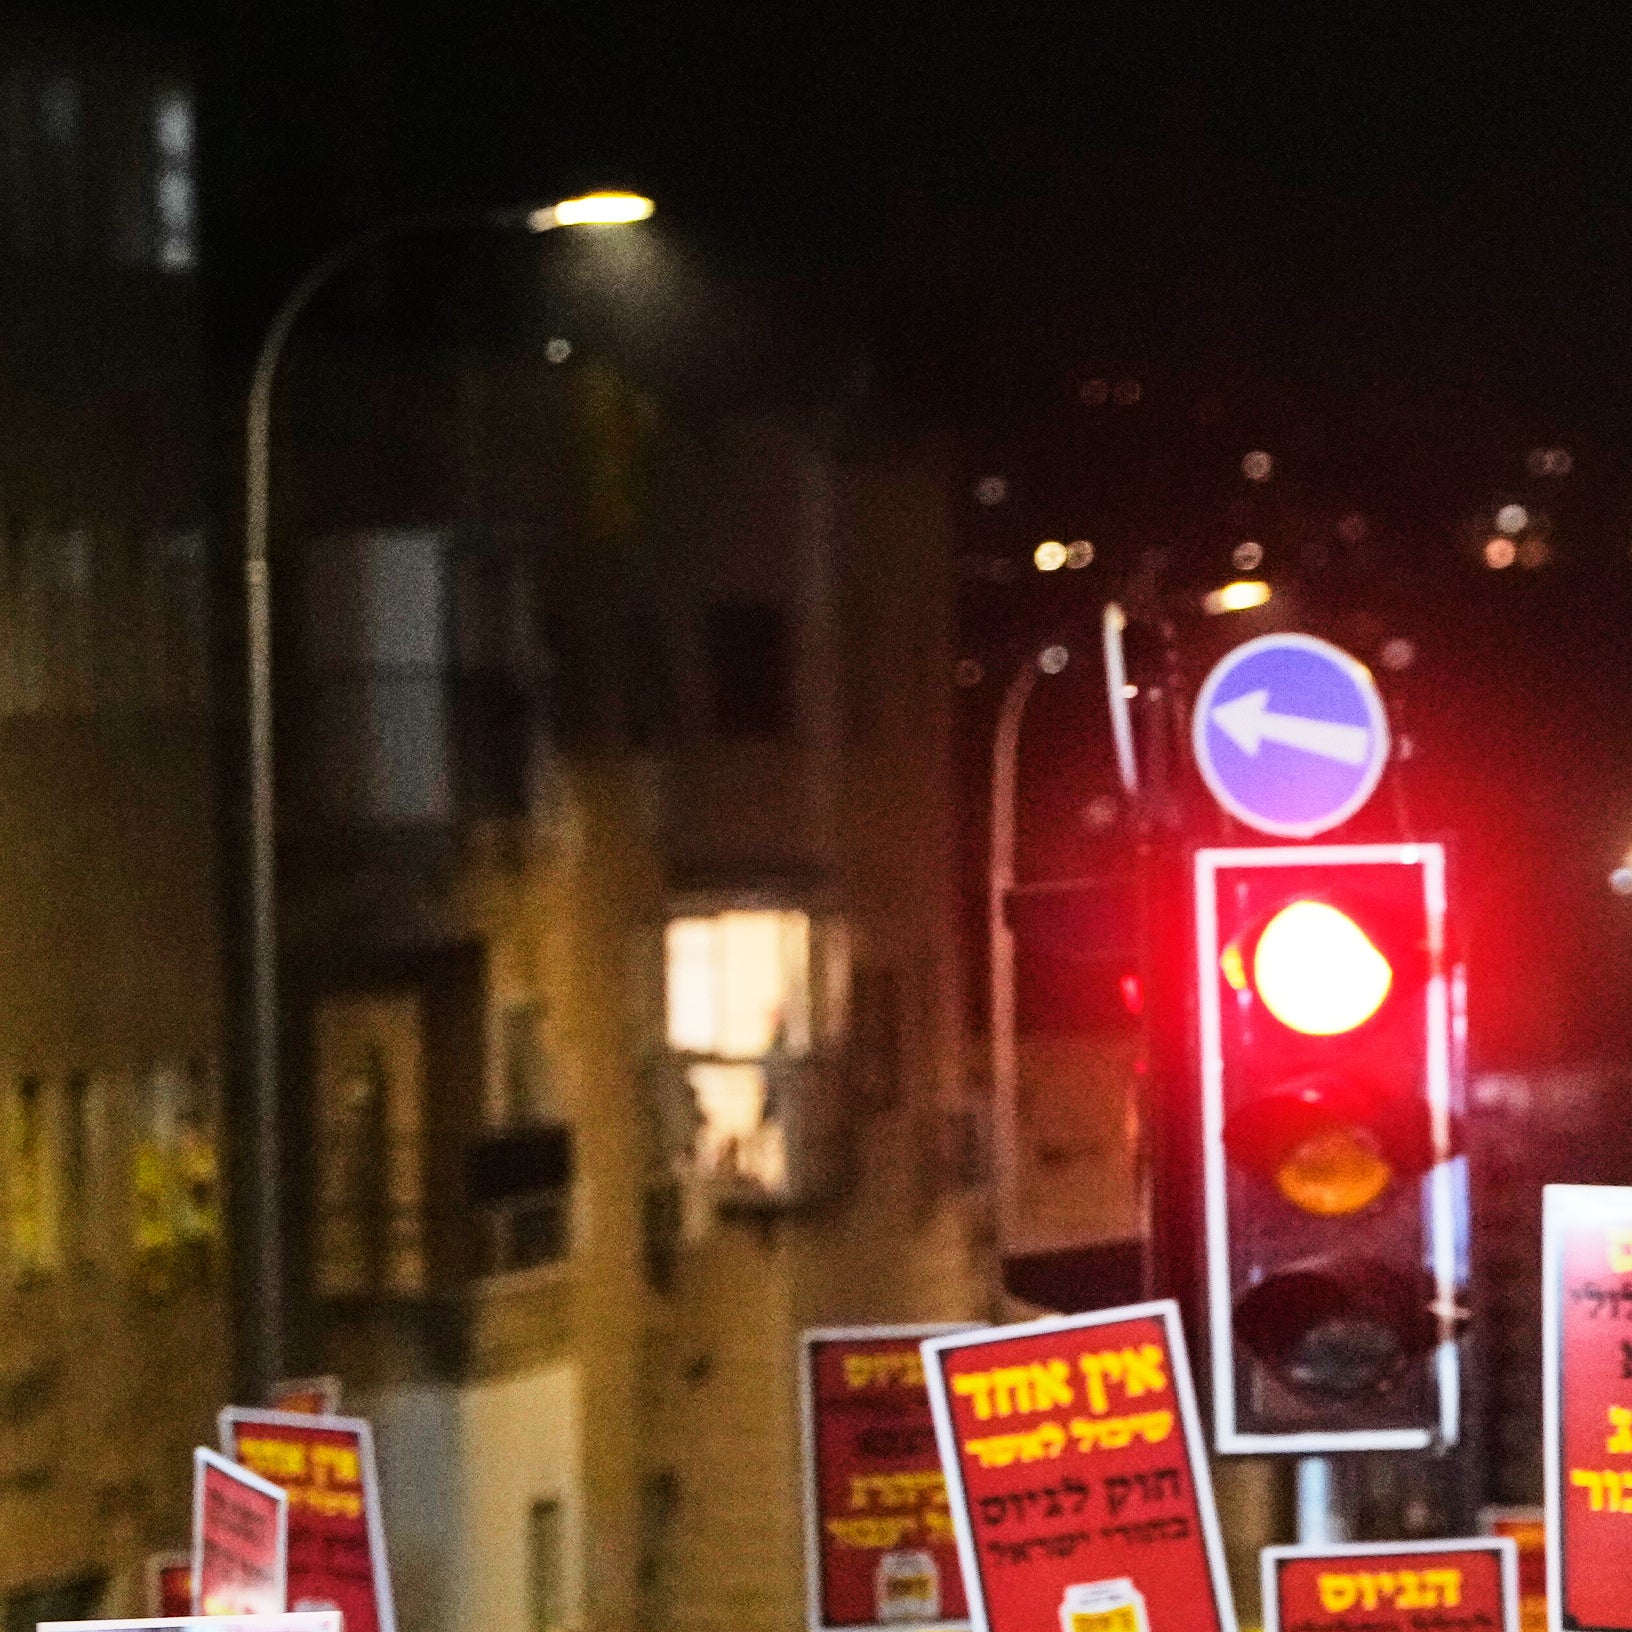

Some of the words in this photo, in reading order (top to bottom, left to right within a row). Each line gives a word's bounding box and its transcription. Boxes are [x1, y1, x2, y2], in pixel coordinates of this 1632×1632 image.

[952, 1359, 1074, 1420] אחד
[1079, 1344, 1167, 1414] אין
[1104, 1468, 1178, 1515] חוק
[1318, 1568, 1463, 1614] הגיוס
